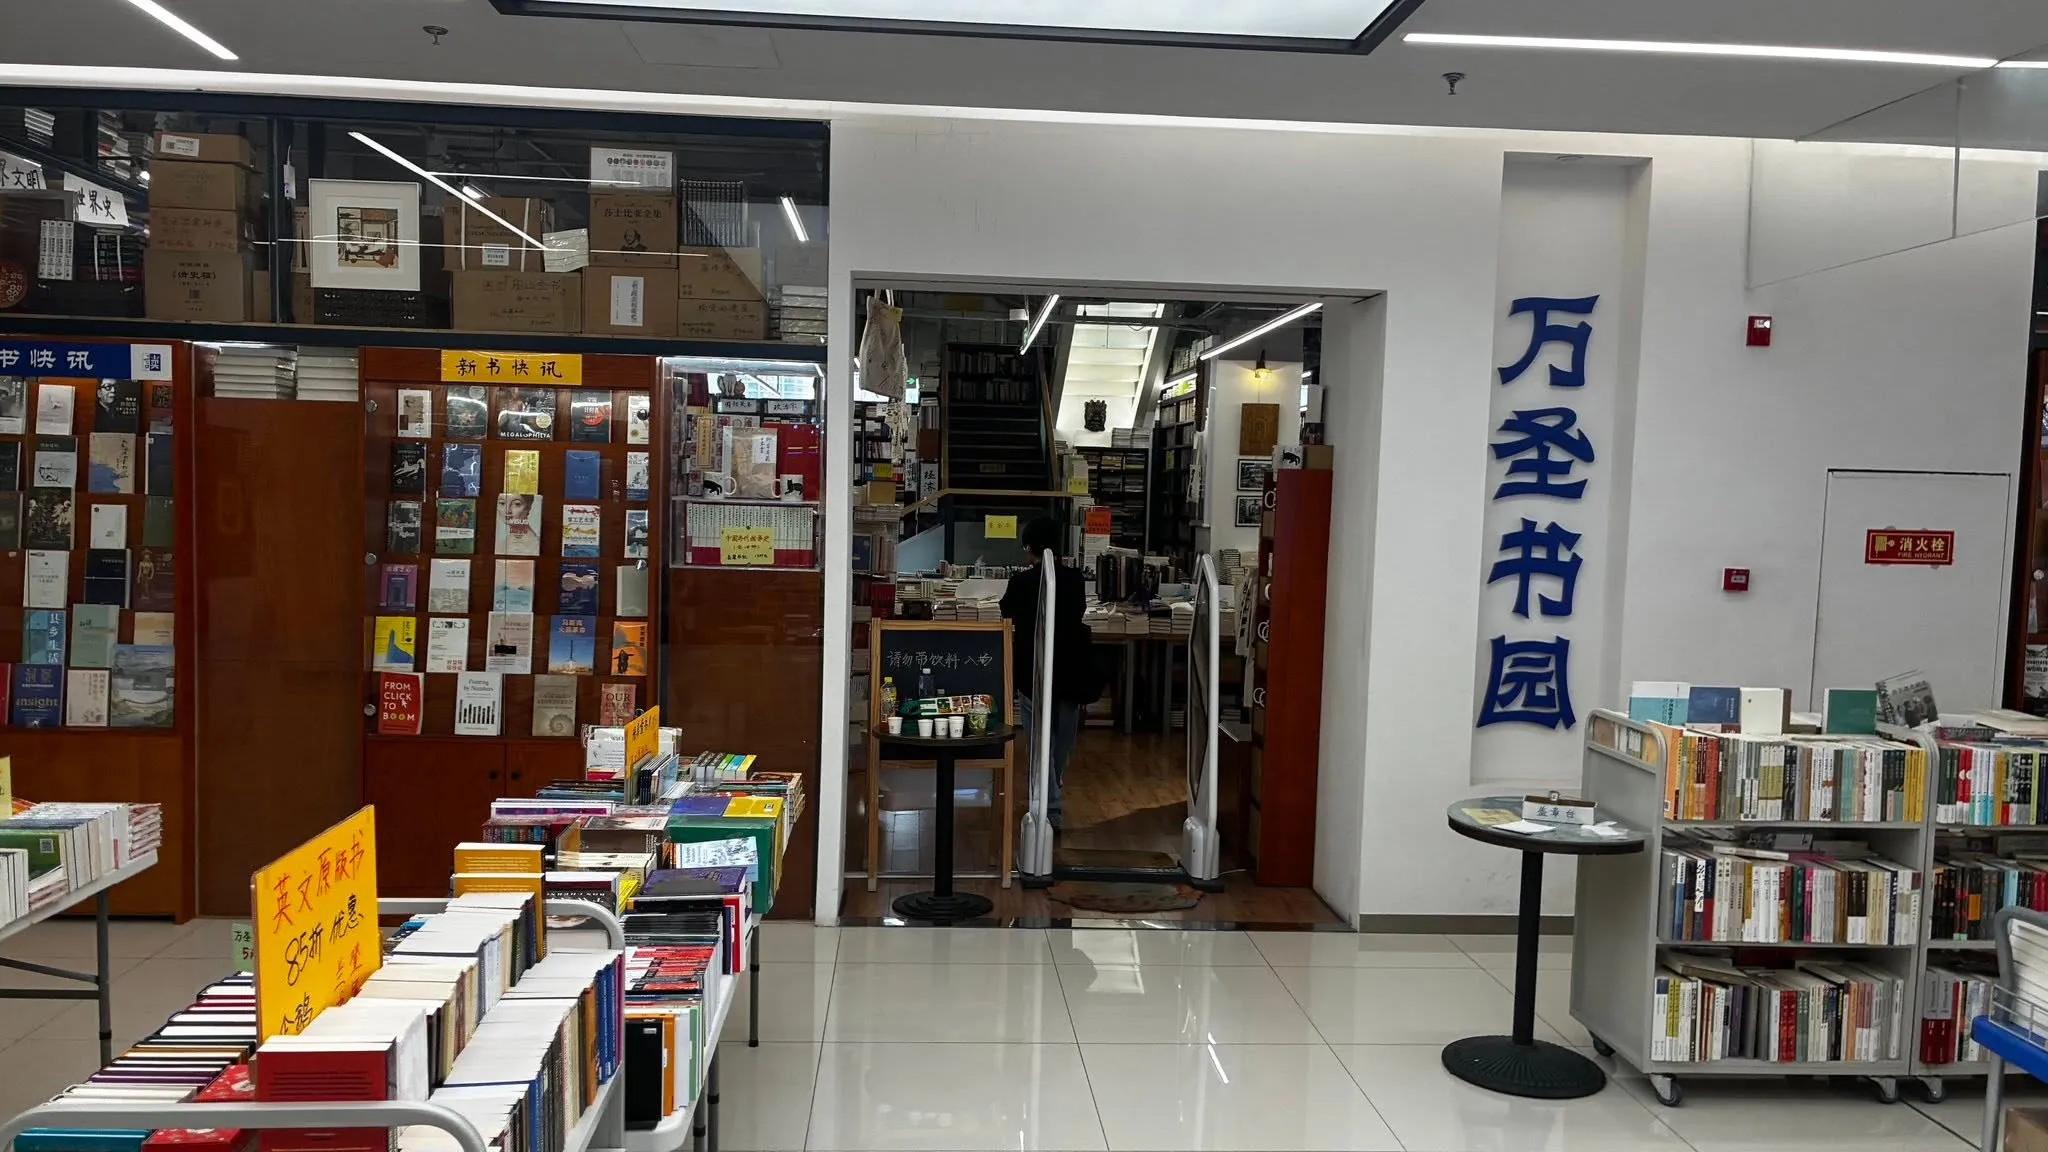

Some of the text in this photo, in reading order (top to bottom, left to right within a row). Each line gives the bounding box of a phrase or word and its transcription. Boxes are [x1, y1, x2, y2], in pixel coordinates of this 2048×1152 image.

[77, 186, 116, 220] 世界史
[456, 357, 564, 379] 新书快讯
[1477, 294, 1600, 730] 万圣书园
[1900, 536, 1945, 552] 消火栓
[384, 681, 411, 690] FROM
[384, 691, 412, 701] CLICK
[606, 692, 631, 702] OUR
[384, 702, 396, 710] TO
[383, 712, 415, 721] BOOM
[273, 829, 365, 934] 英文原版书
